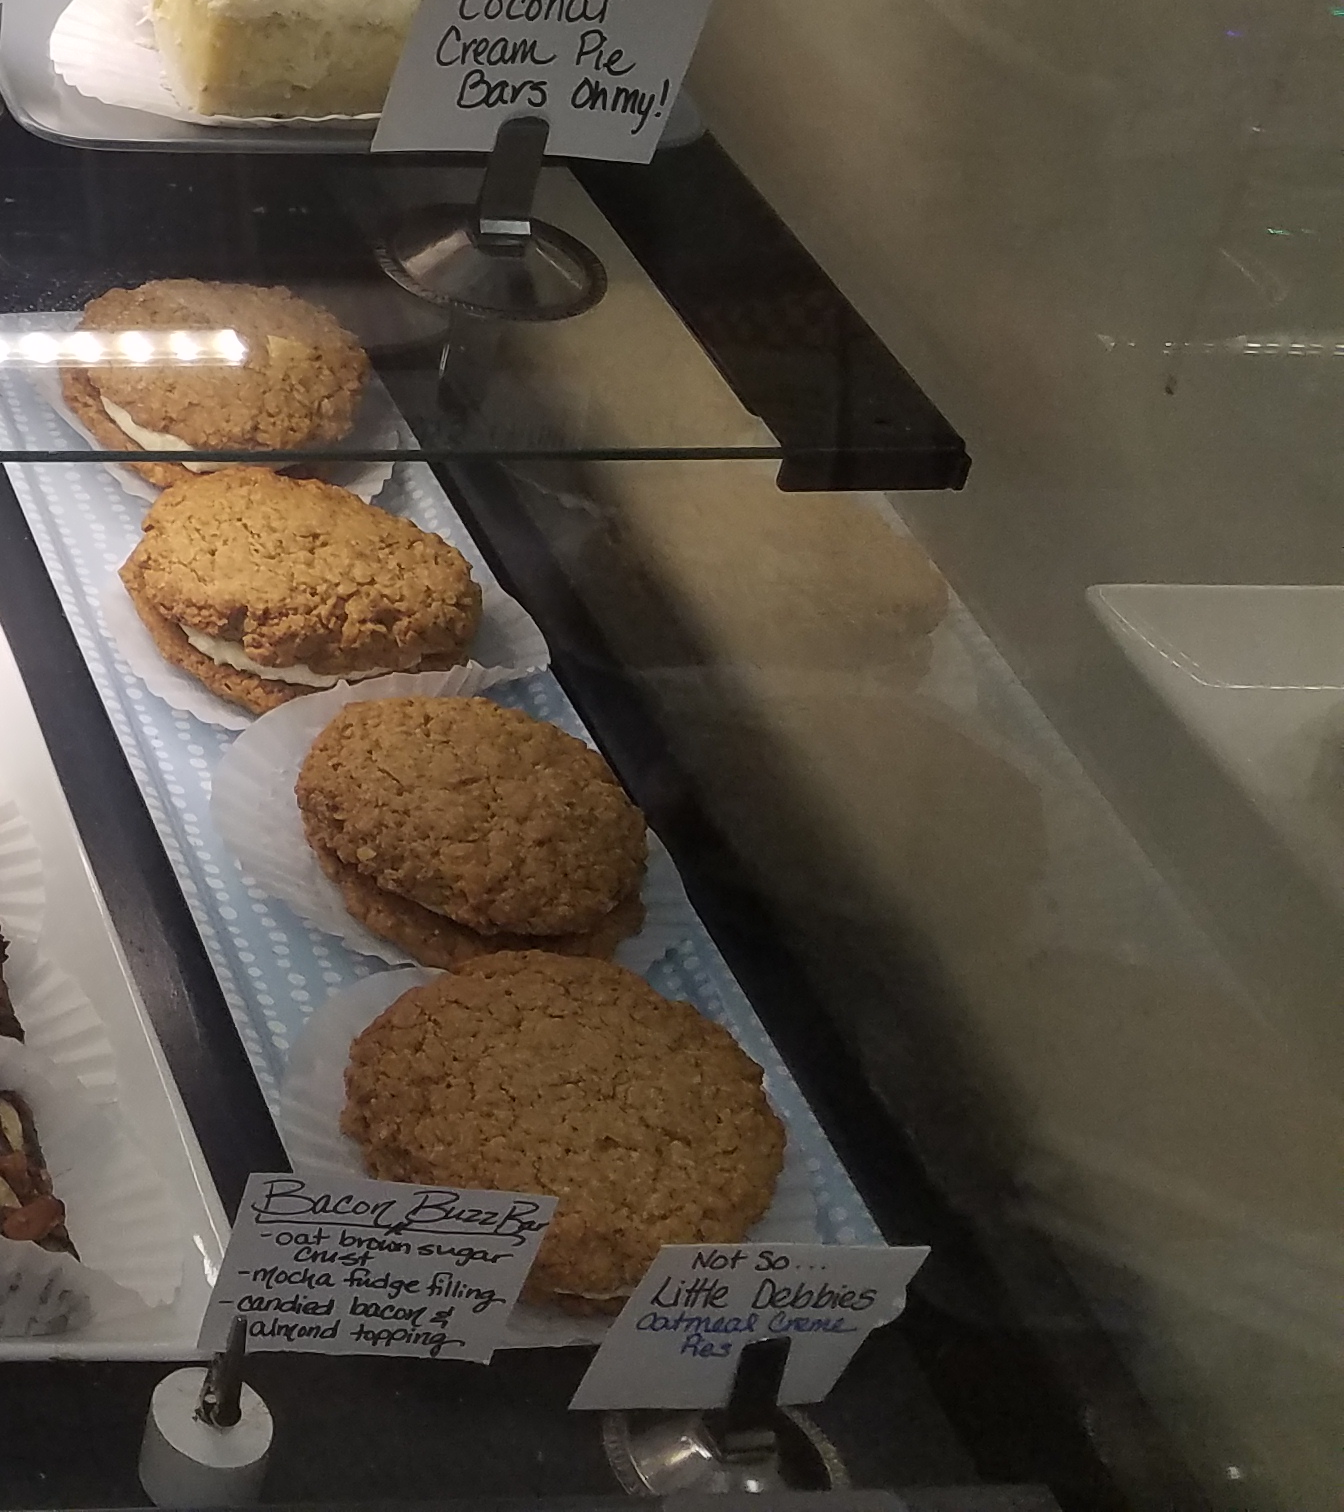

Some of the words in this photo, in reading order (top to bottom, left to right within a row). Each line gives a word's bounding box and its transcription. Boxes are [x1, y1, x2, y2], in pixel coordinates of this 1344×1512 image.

[435, 24, 558, 67] Cream
[575, 28, 637, 77] Pie
[456, 67, 548, 110] Bars
[250, 1178, 398, 1230] Bacon
[404, 1190, 499, 1228] Buzz
[338, 1230, 412, 1255] brown
[417, 1242, 514, 1266] sugar
[691, 1250, 748, 1271] Not
[343, 1268, 421, 1299] fudge
[426, 1271, 506, 1314] filling
[650, 1275, 729, 1310] Little
[750, 1277, 878, 1311] Debbies
[349, 1296, 428, 1328] bacon
[636, 1310, 759, 1334] Oatmeal
[248, 1317, 342, 1342] almond
[349, 1320, 466, 1358] topping
[679, 1333, 733, 1358] Pies
